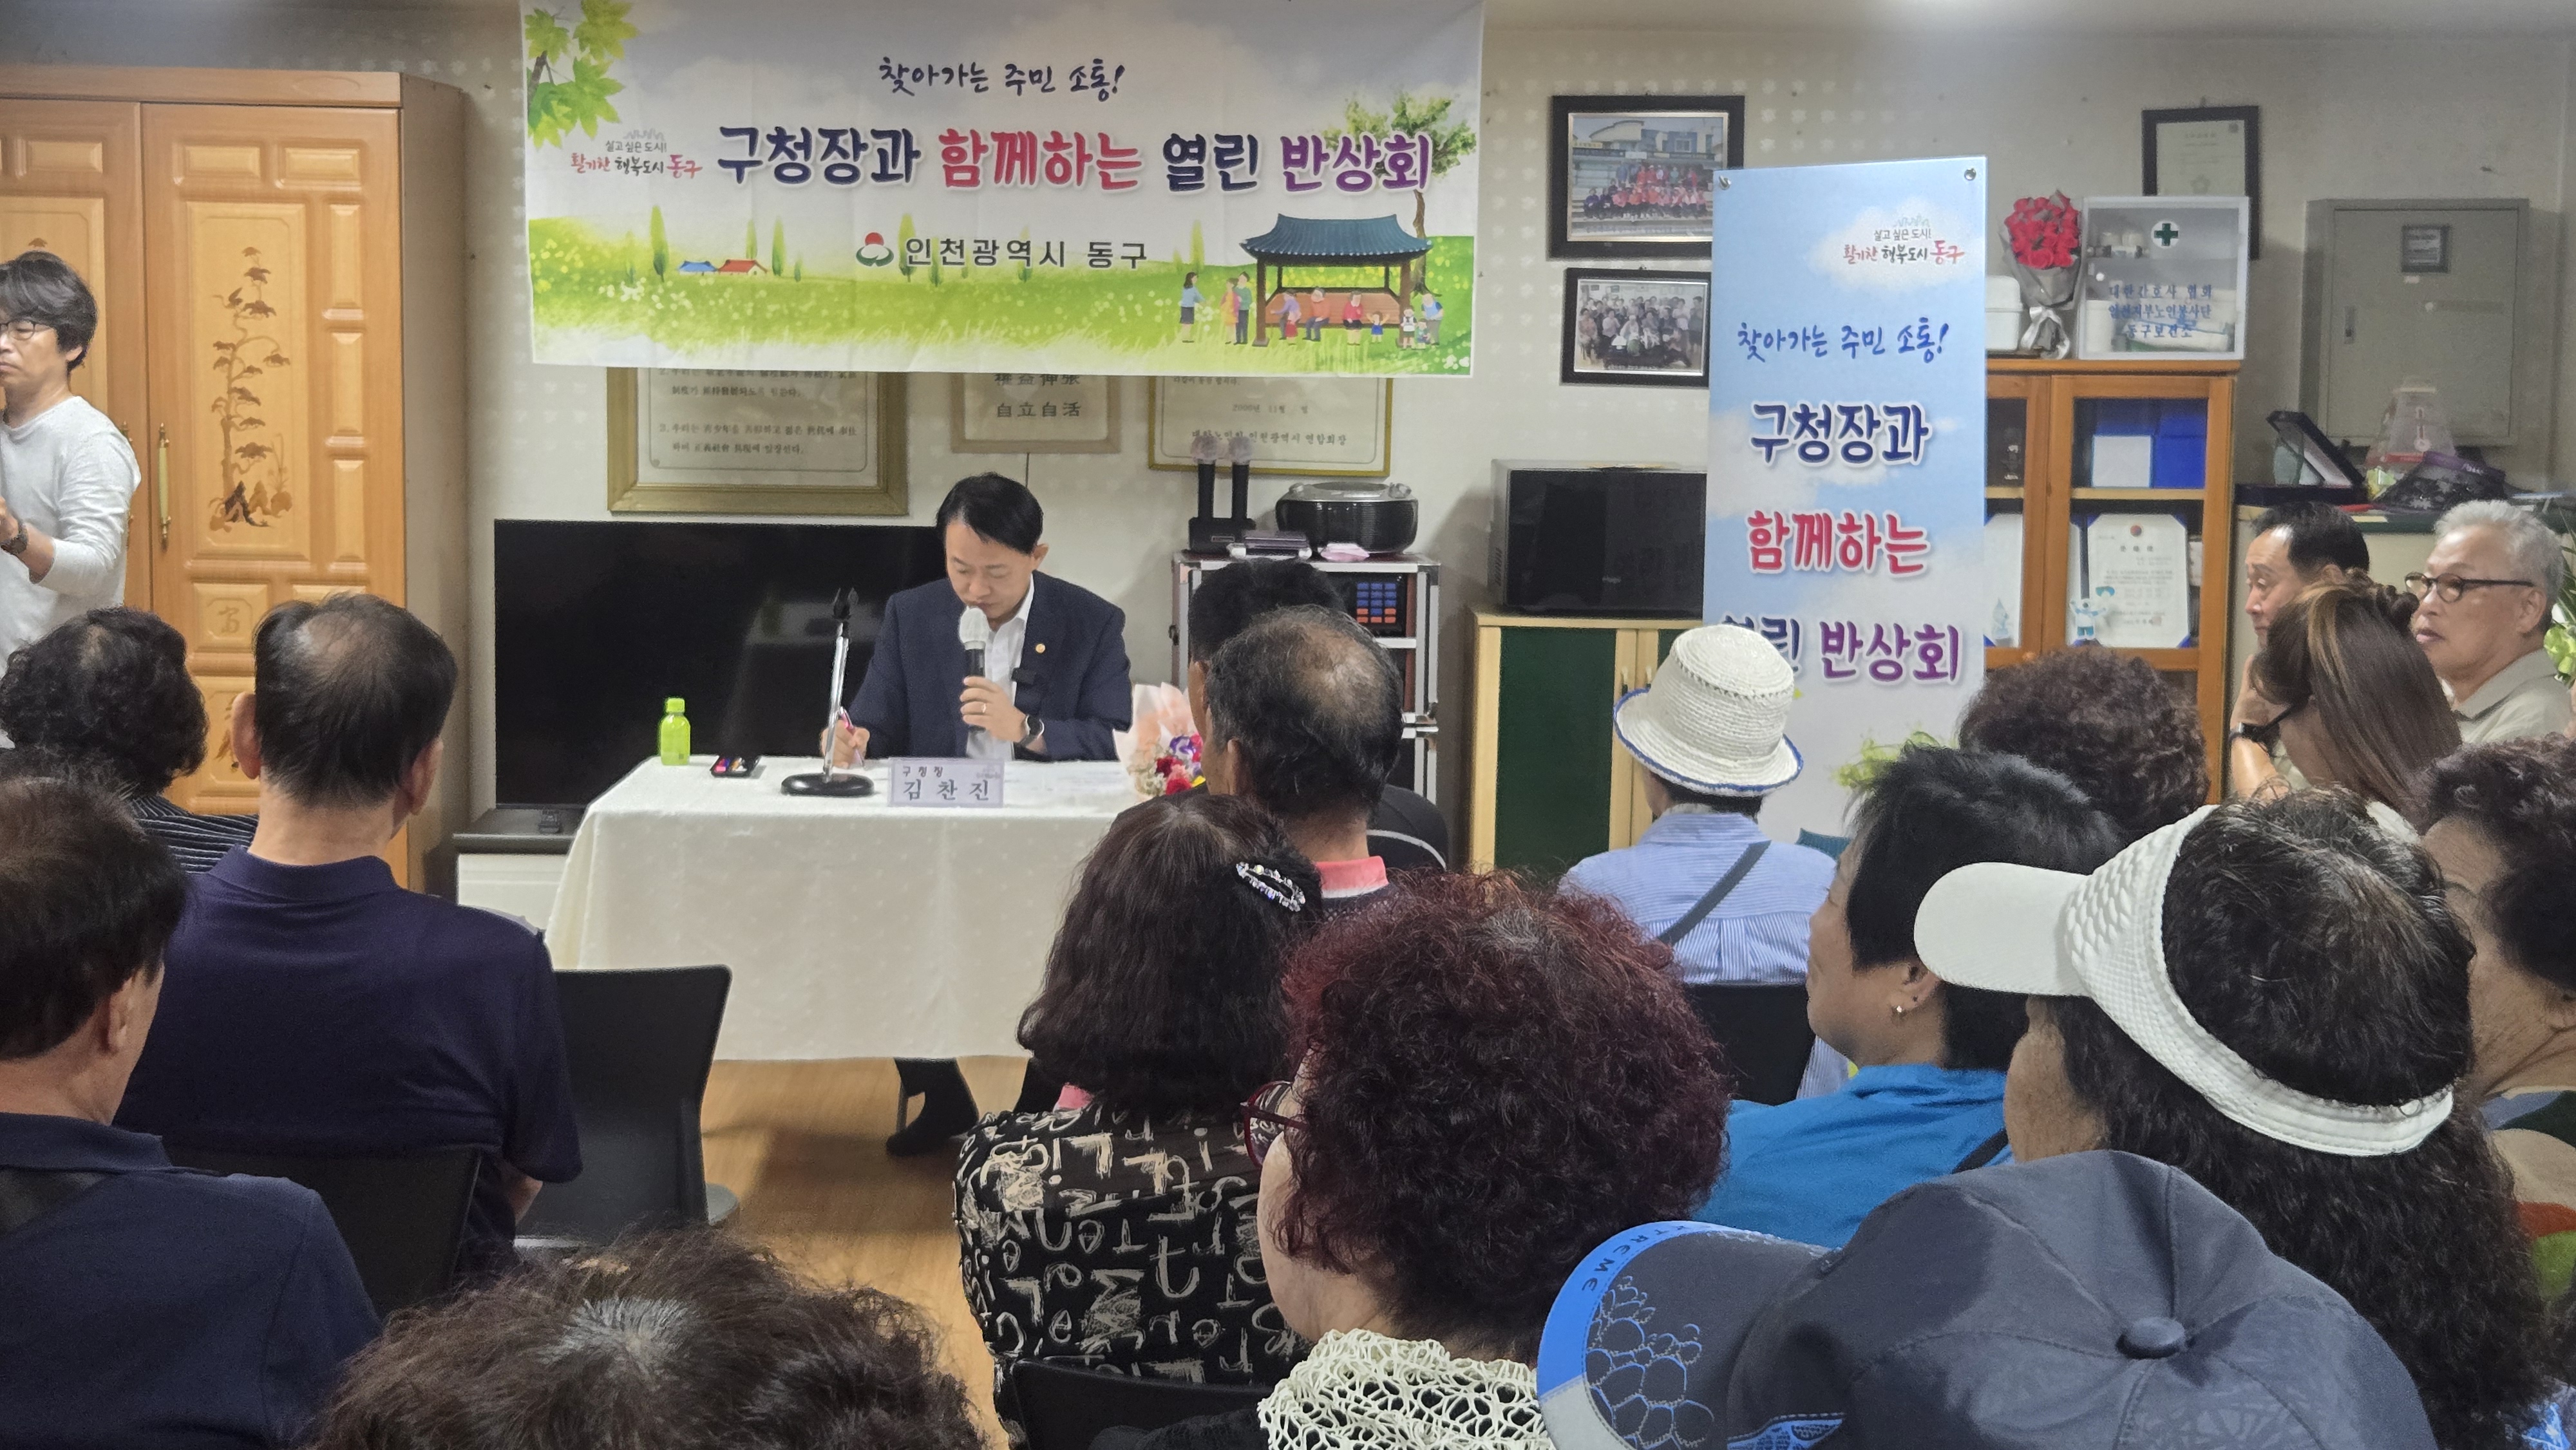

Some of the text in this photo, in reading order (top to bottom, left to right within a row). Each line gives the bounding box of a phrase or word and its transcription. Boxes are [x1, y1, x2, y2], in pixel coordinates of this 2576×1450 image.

[878, 56, 1125, 102] 찾아가는 주민 소통!
[606, 140, 667, 153] 살고 싶은 도시!
[717, 126, 1430, 192] 구청장과 함께하는 열린 반상회
[571, 152, 703, 179] 활기찬 행복도시 동구
[1873, 228, 1932, 241] 살고 싶은 도시!
[905, 238, 1148, 270] 인천광역시 동구
[1842, 240, 1965, 265] 활기찬 행복도시 동구
[1738, 317, 1949, 364] 찾아가는 주민 소통!
[997, 401, 1082, 417] 自立自活
[1750, 403, 1929, 464] 구청장과
[1747, 510, 1927, 574] 함께하는
[1722, 615, 1959, 681] 린 반상회
[902, 765, 944, 778] 구청장
[903, 778, 990, 801] 김찬진
